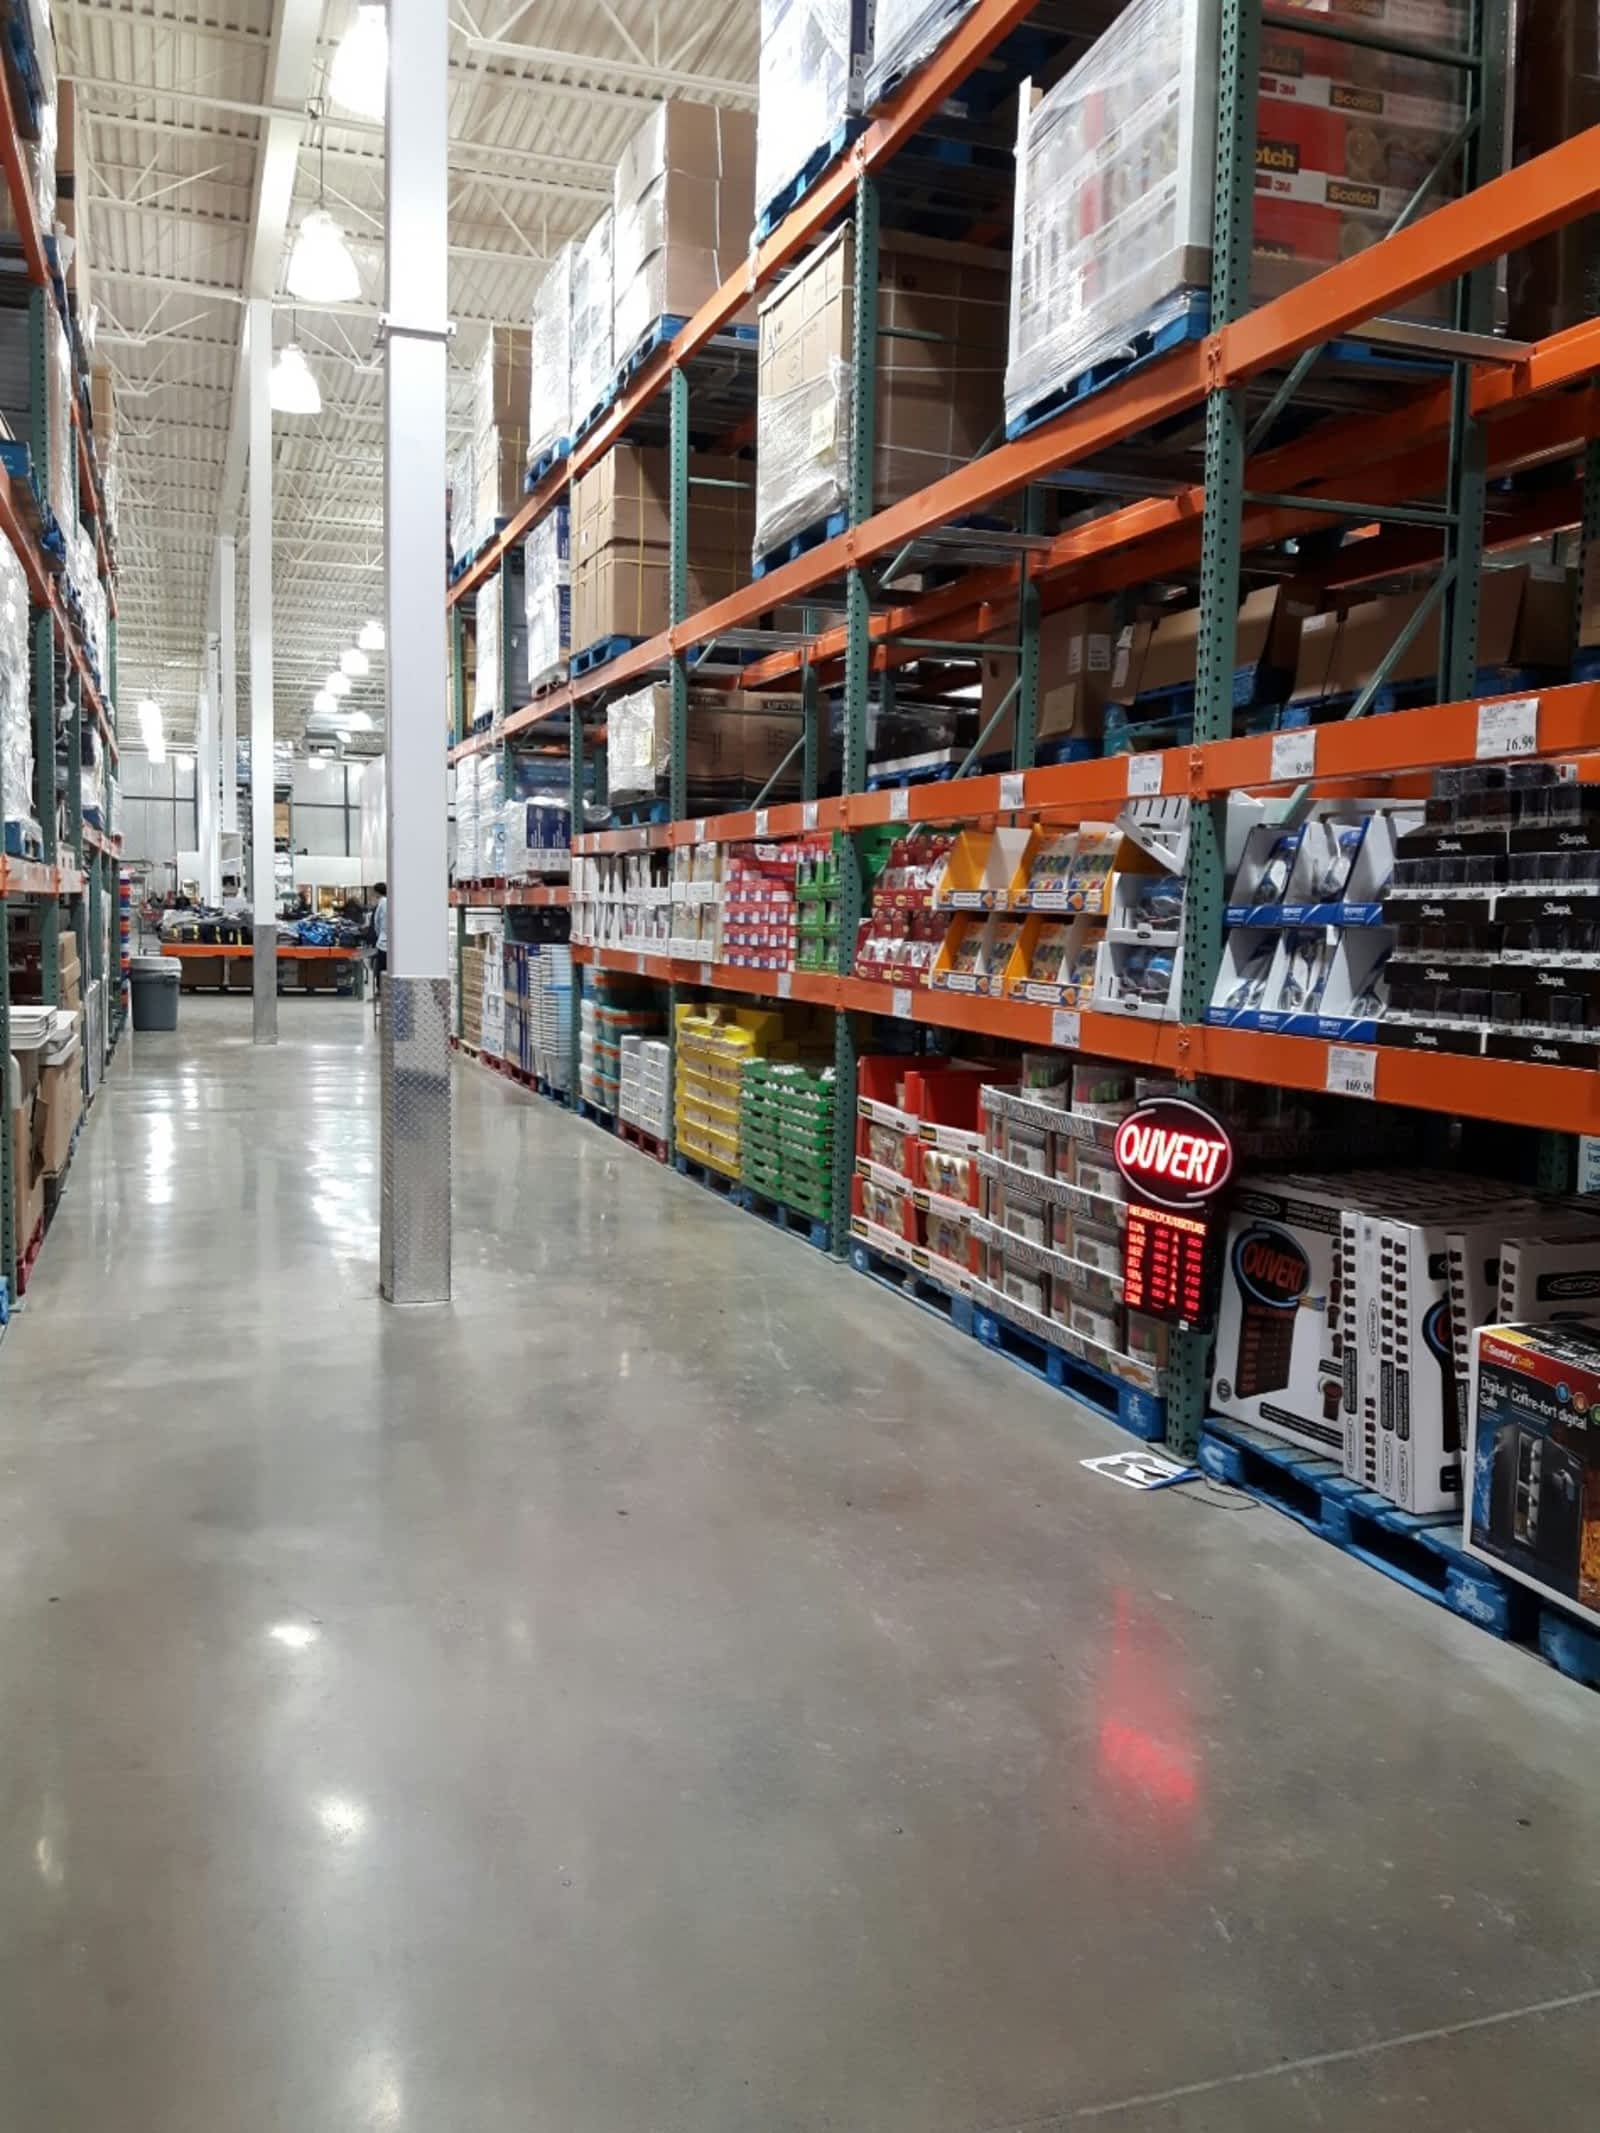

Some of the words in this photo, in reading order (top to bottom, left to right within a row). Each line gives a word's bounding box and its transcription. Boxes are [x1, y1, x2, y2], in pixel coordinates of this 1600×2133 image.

[1329, 185, 1377, 205] Scotch
[1505, 735, 1535, 752] 16.99
[1120, 1123, 1226, 1185] OUVERT
[1243, 1243, 1306, 1293] OUVERT
[1481, 1376, 1508, 1398] Digital
[1480, 1391, 1498, 1411] Safe
[1511, 1389, 1557, 1418] Coffre-fort
[1558, 1408, 1588, 1432] digital
